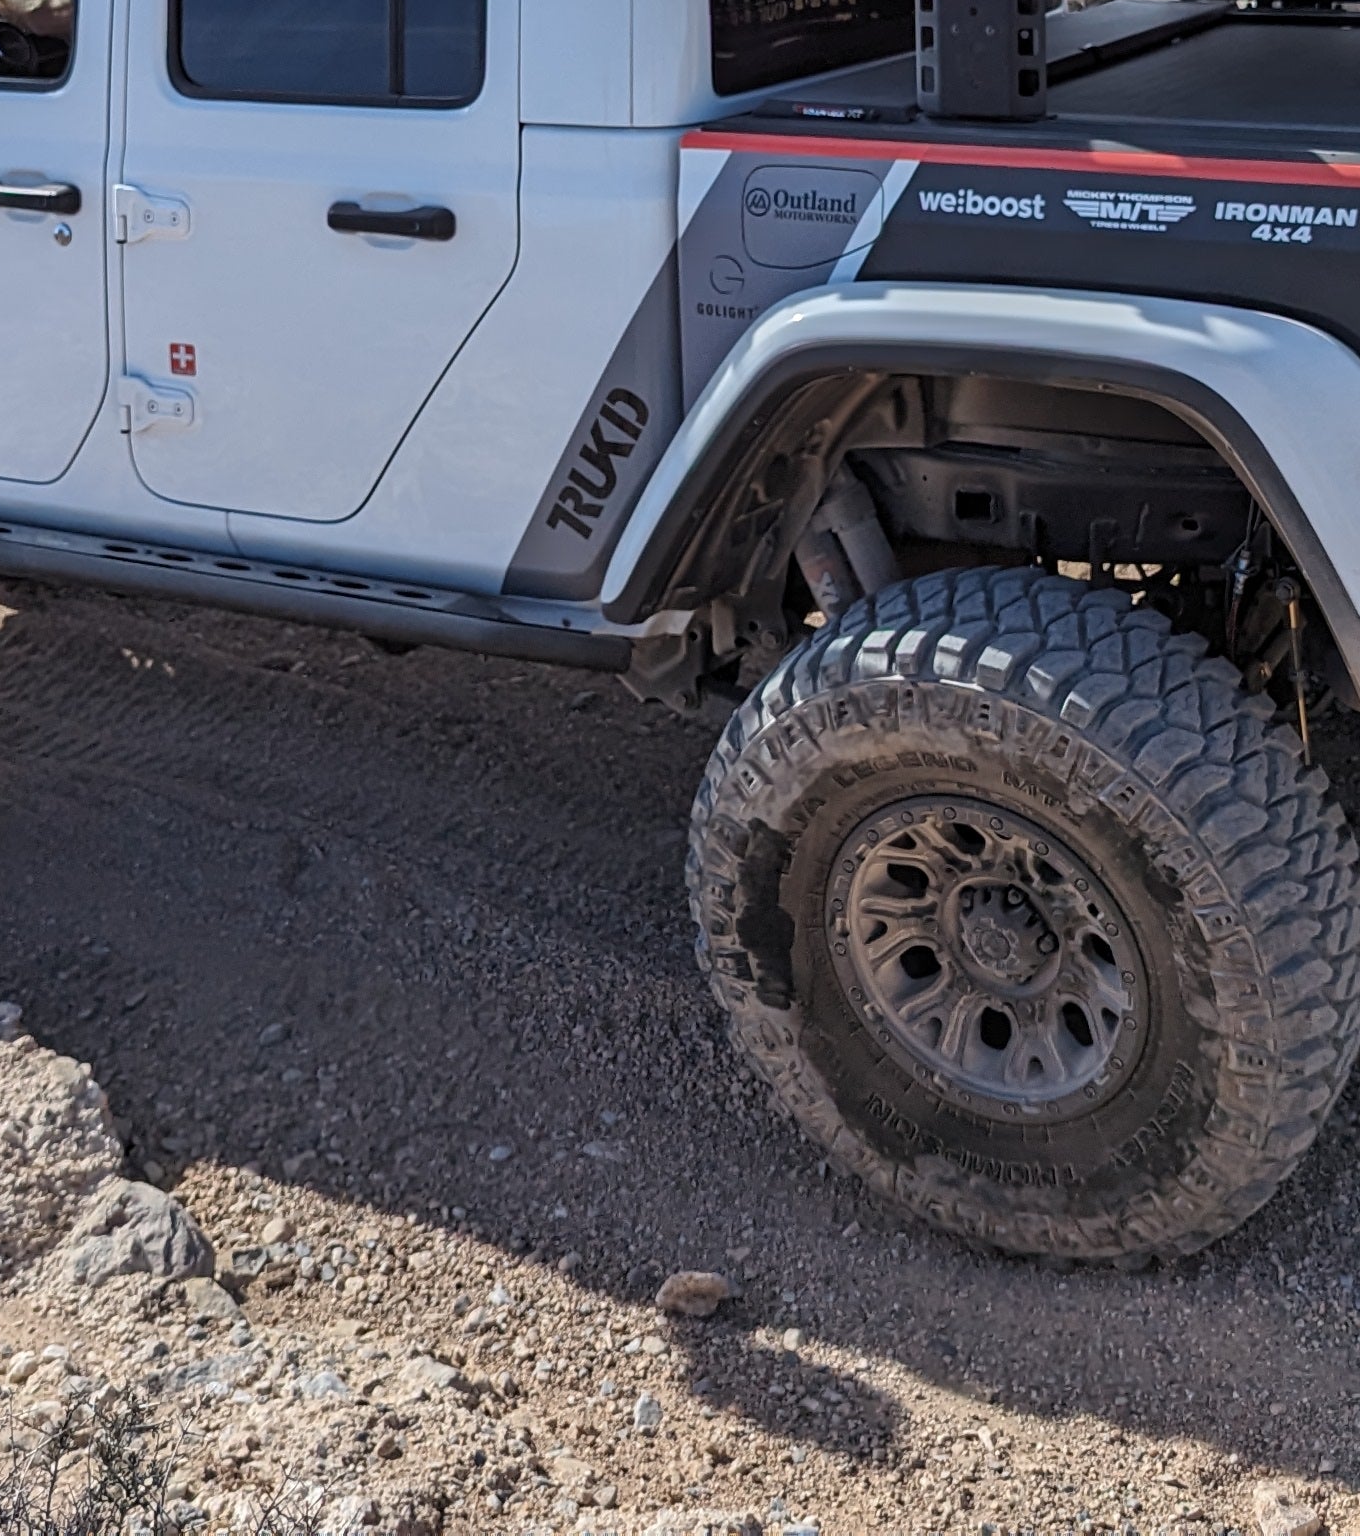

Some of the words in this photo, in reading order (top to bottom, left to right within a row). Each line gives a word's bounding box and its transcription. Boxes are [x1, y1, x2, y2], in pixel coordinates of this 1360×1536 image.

[772, 188, 858, 214] Outland
[1066, 189, 1116, 201] MICKEY
[1117, 192, 1193, 204] THOMPSON
[773, 209, 859, 226] MOTORWORKS
[1213, 201, 1359, 227] IRONMAN
[1250, 223, 1313, 244] 4x4
